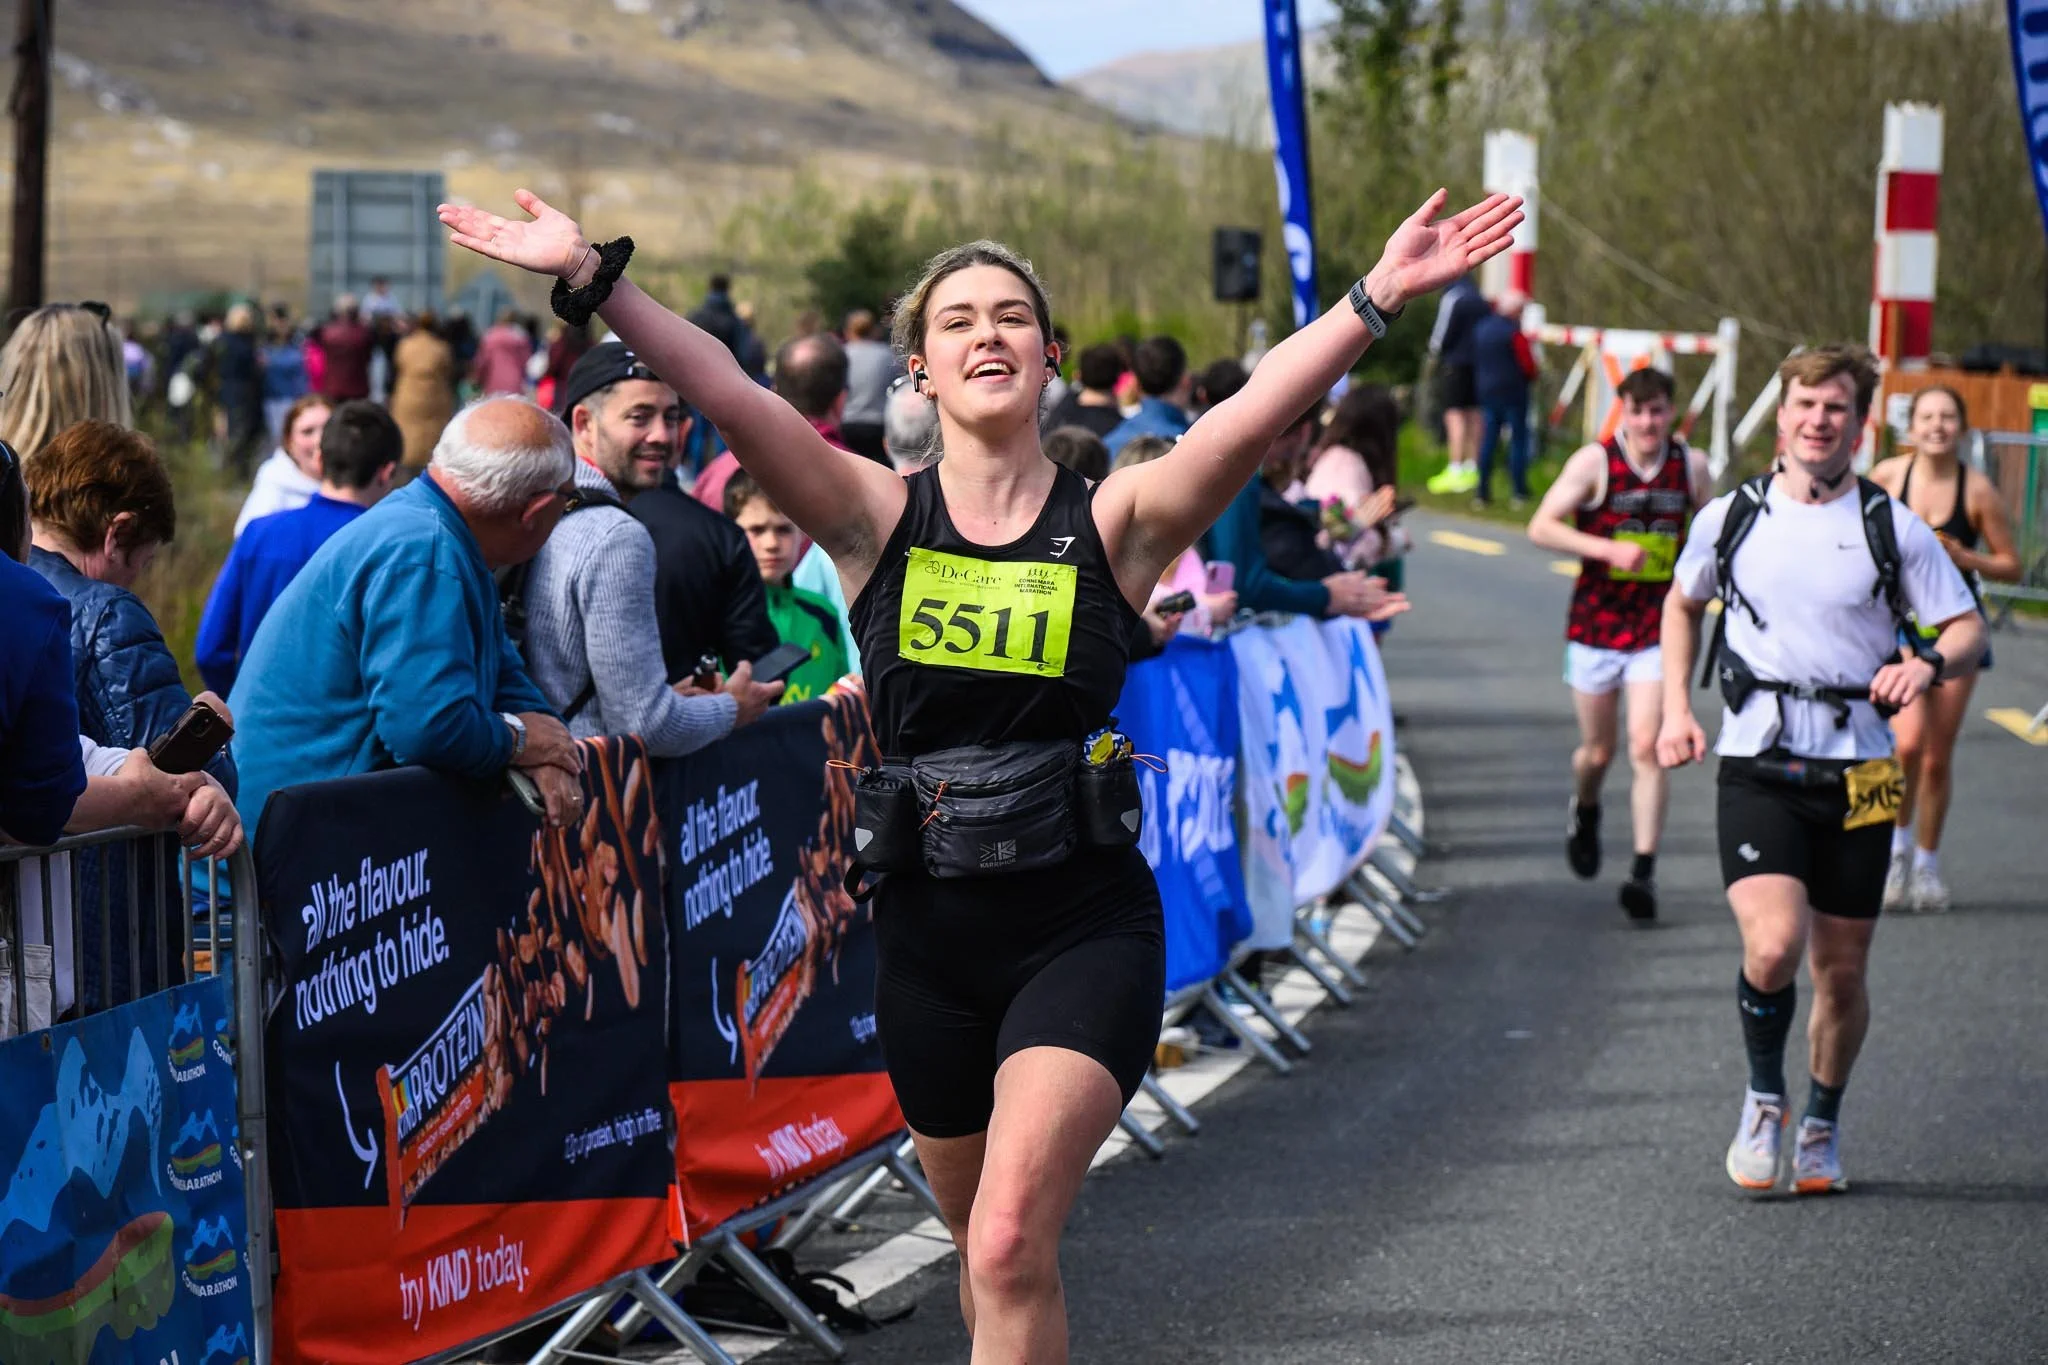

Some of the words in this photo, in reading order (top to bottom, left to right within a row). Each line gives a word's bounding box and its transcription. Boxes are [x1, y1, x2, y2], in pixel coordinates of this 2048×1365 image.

[941, 564, 1002, 585] DeCare
[1014, 583, 1058, 591] INTERNATIONAL
[1019, 588, 1052, 596] MARATHON
[911, 598, 1050, 664] 5511
[680, 803, 697, 865] all
[696, 798, 718, 853] the
[301, 881, 326, 953] all
[326, 872, 356, 939] the
[359, 847, 431, 922] flavour.
[683, 859, 733, 931] nothing
[729, 848, 743, 899] to
[743, 826, 774, 890] hide.
[295, 945, 377, 1031] nothing
[374, 931, 399, 989] to
[400, 904, 450, 979] hide.
[409, 992, 486, 1122] PROTEIN
[767, 1123, 812, 1171] KIND
[399, 1271, 424, 1332] try
[426, 1247, 472, 1311] KIND
[475, 1233, 530, 1293] today.
